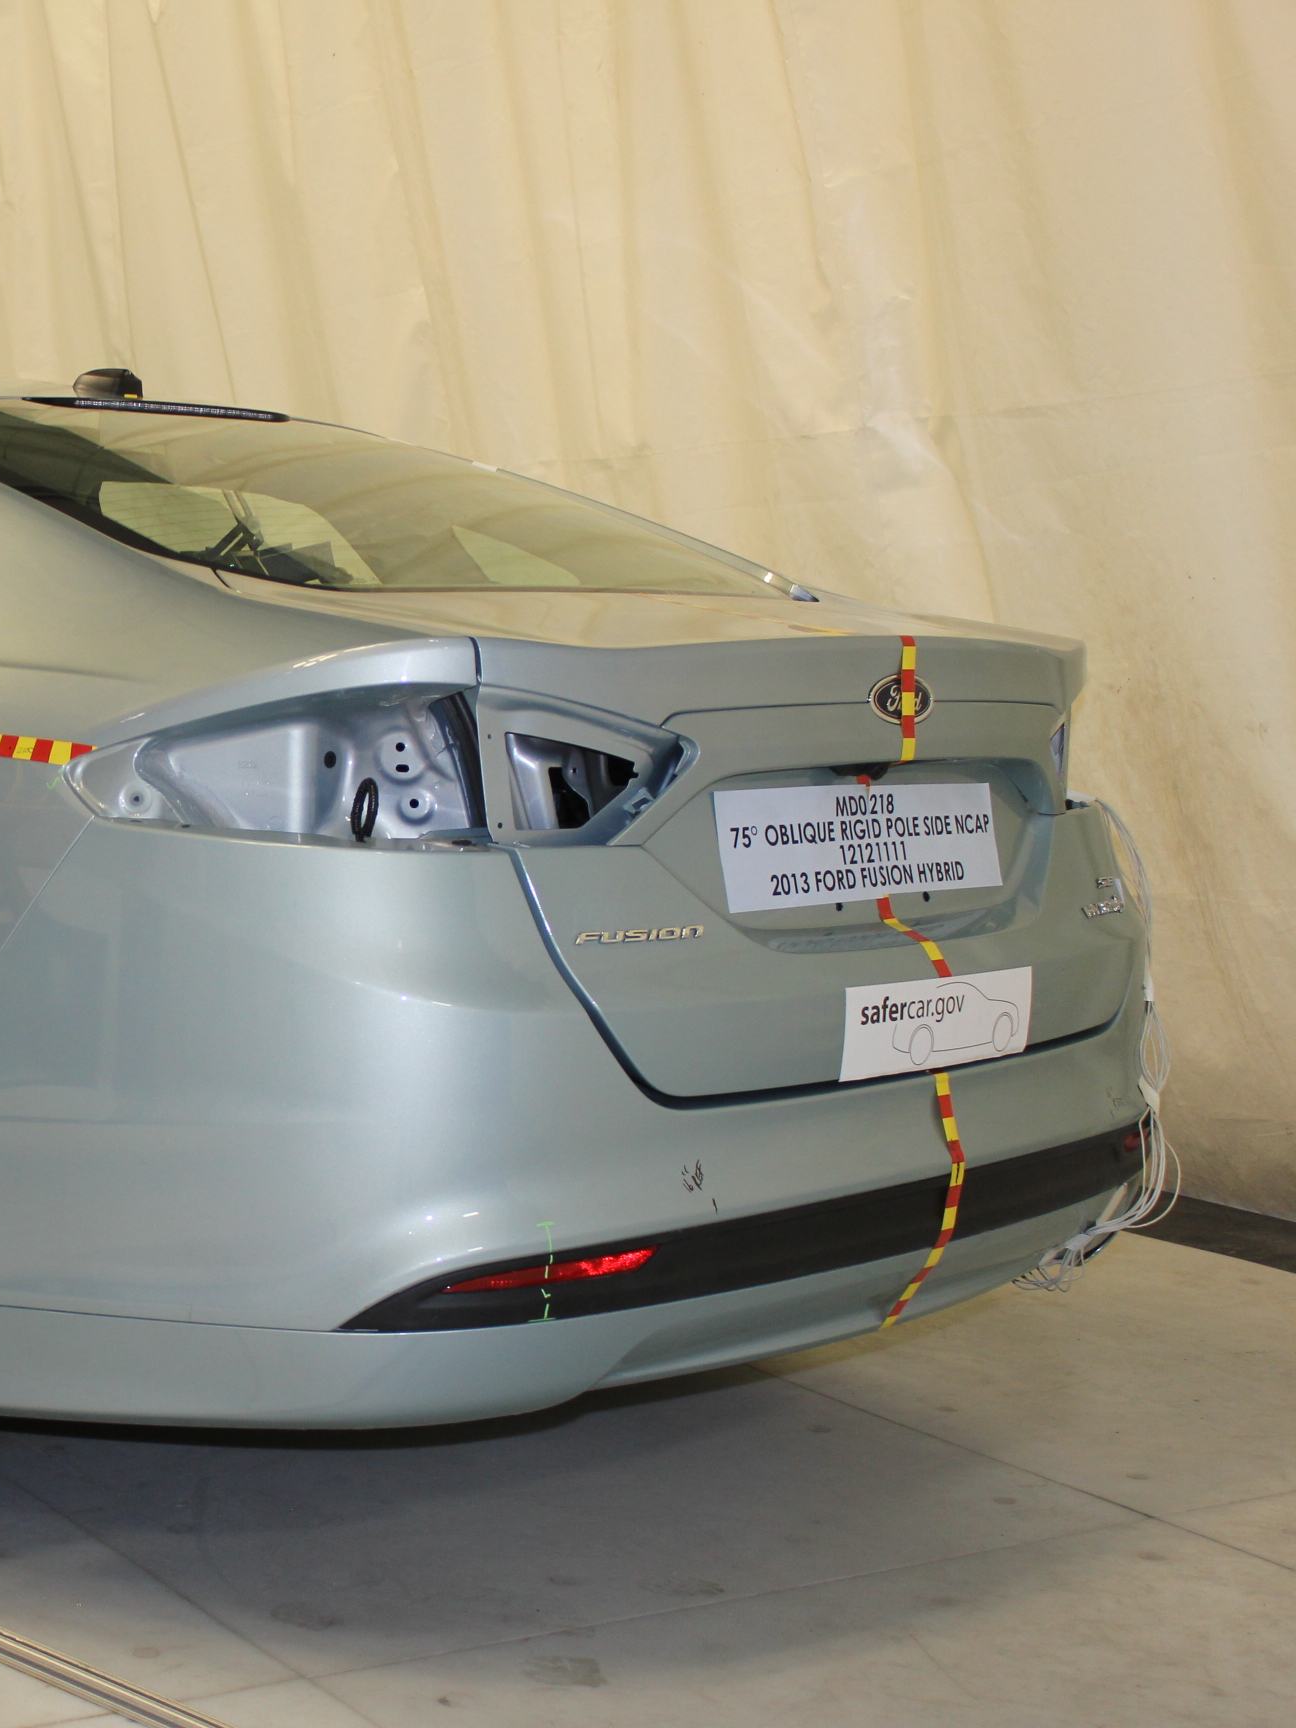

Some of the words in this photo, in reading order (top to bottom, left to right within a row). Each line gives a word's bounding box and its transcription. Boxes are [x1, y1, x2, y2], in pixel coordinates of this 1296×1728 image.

[765, 821, 835, 847] OBLIQUE
[840, 818, 882, 841] RIGID
[886, 816, 921, 838] POLE
[924, 815, 952, 836] SIDE
[954, 813, 990, 834] NCAP
[839, 841, 907, 865] 12121111
[770, 872, 810, 896] 2013
[815, 869, 856, 893] FORD
[861, 864, 914, 888] FUSION
[918, 860, 965, 884] HYBRID
[575, 924, 704, 946] FUSION
[860, 994, 965, 1026] safercar.gov
